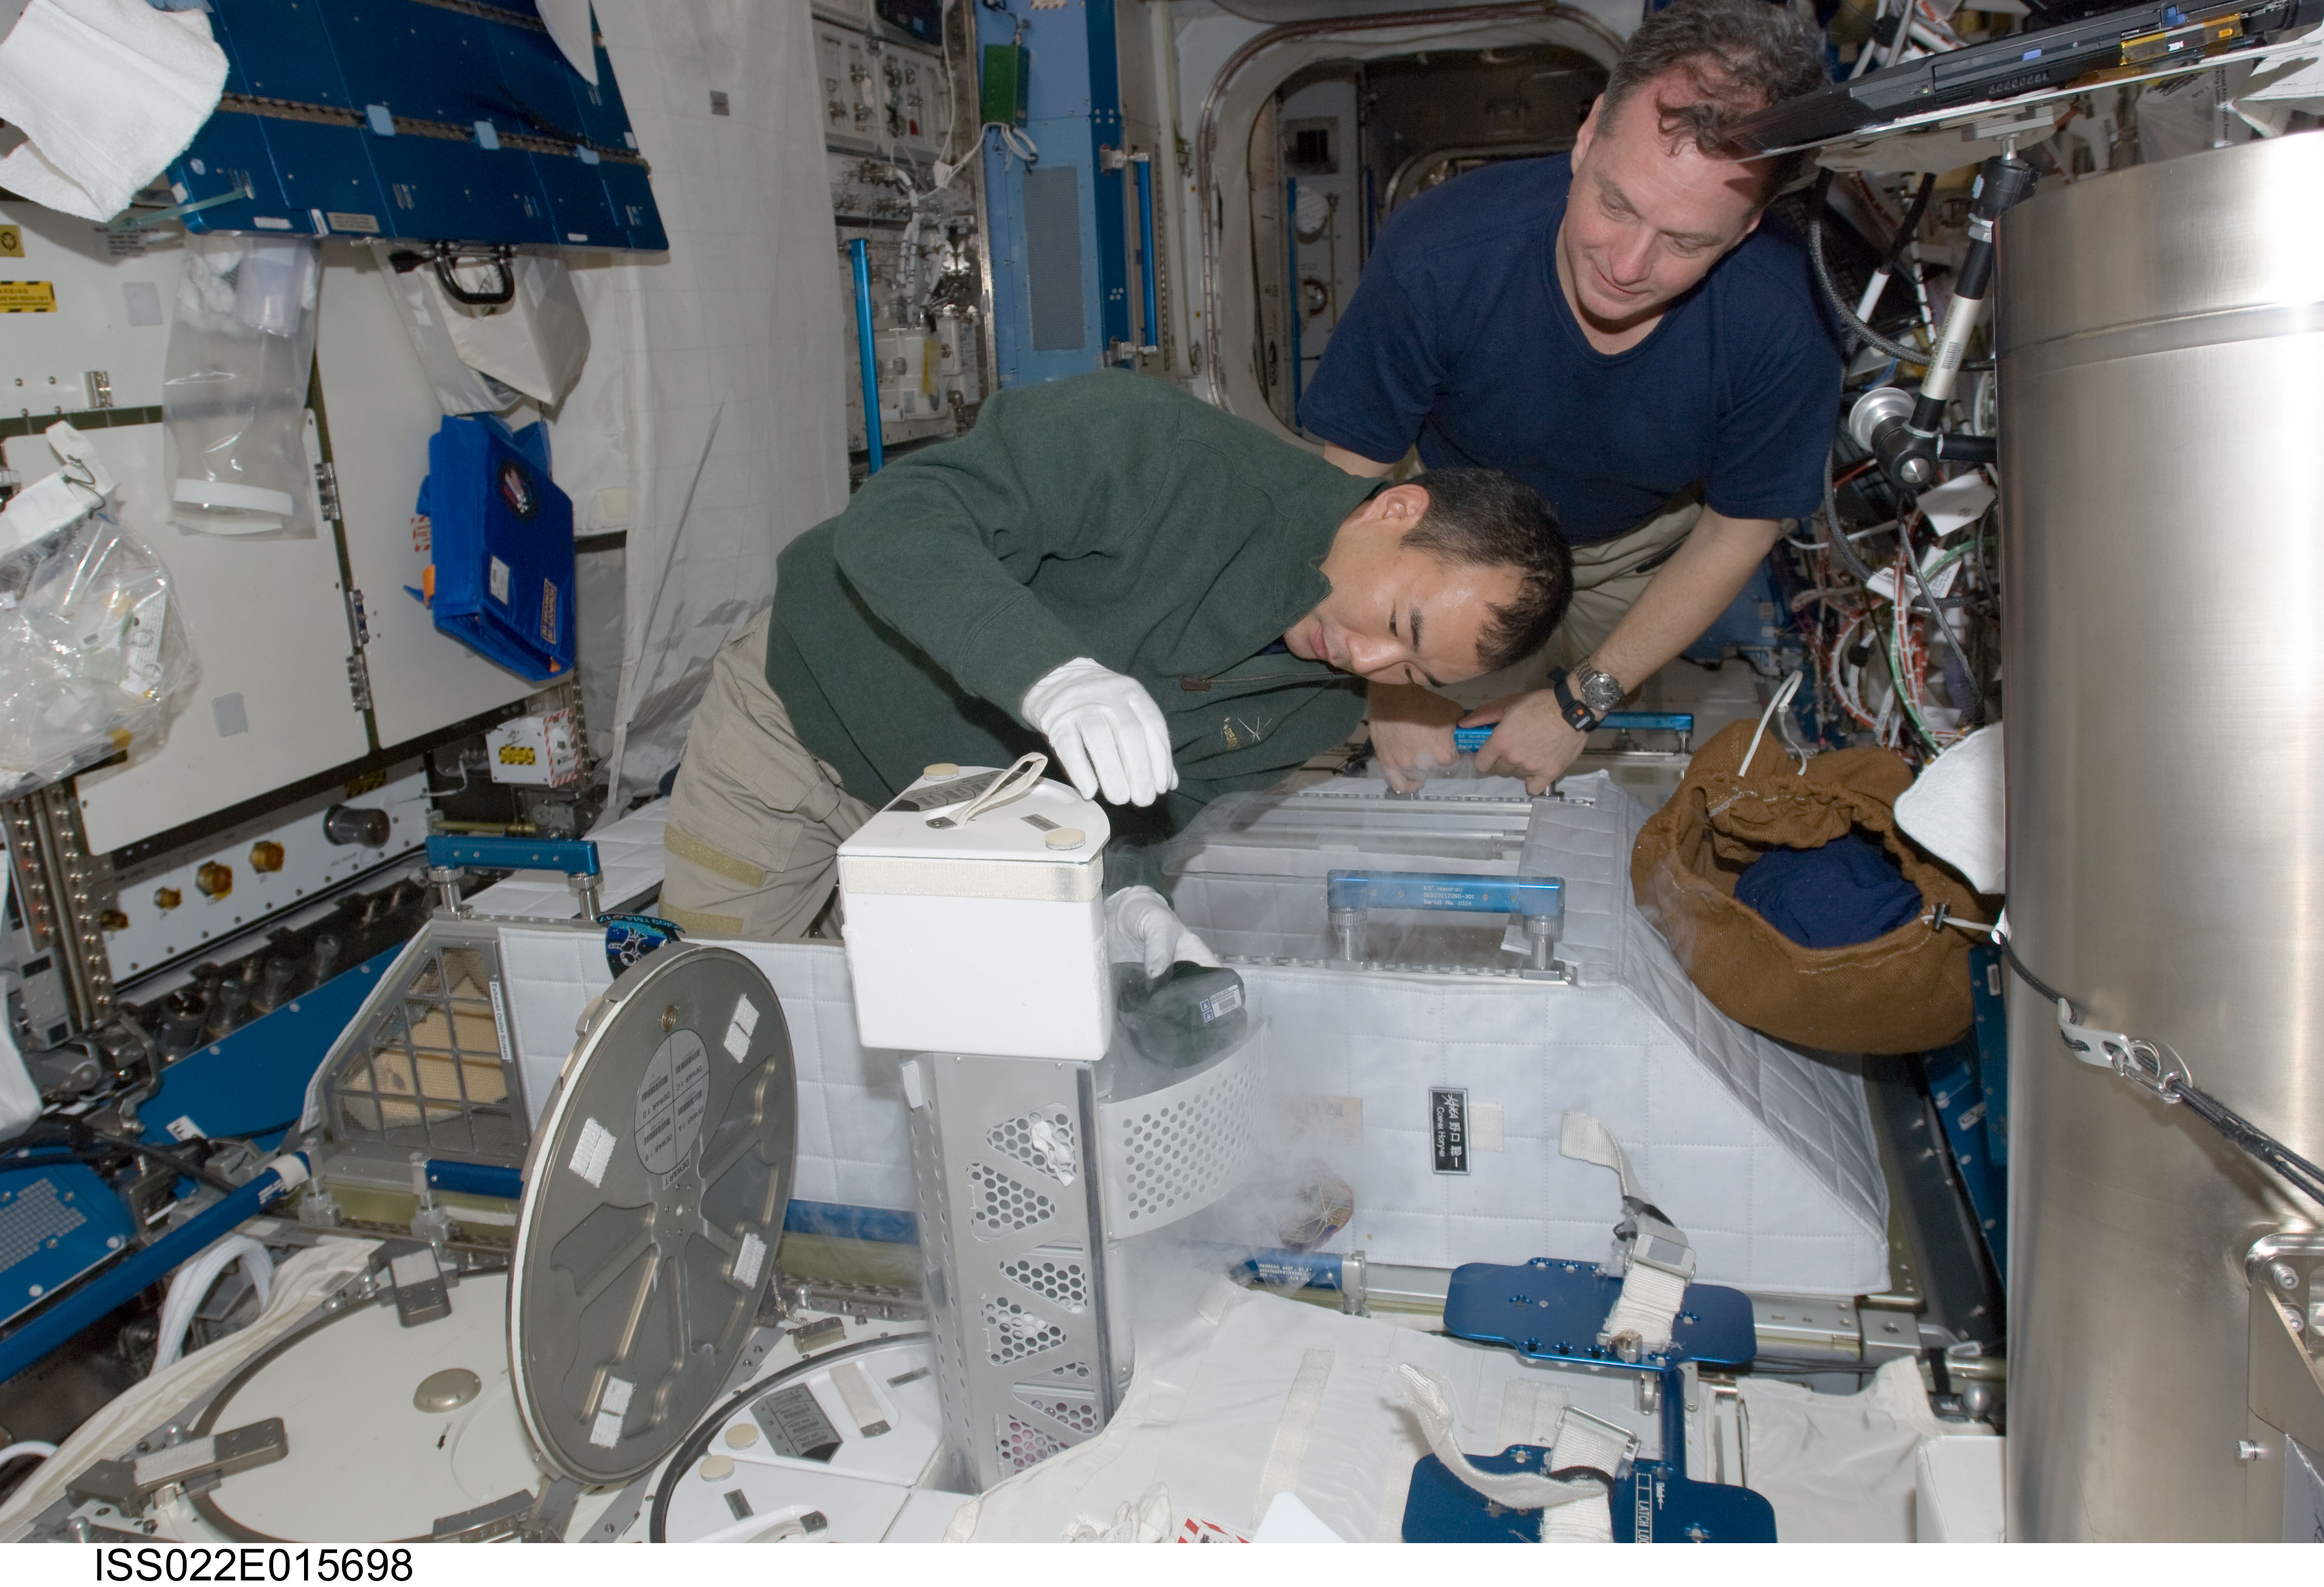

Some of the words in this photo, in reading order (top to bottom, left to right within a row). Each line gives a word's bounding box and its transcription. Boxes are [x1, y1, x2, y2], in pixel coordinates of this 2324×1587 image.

[492, 983, 501, 1011] Exhaust
[496, 1013, 505, 1033] Outlet
[685, 1065, 702, 1083] DEWAR
[653, 1092, 670, 1110] DEWAR
[687, 1106, 703, 1125] DEWAR
[1437, 1106, 1445, 1130] Соичи
[655, 1133, 672, 1153] DEWAR
[1437, 1131, 1445, 1157] Ногучи
[669, 1158, 689, 1183] DEWAR
[1638, 1500, 1650, 1527] LATCH
